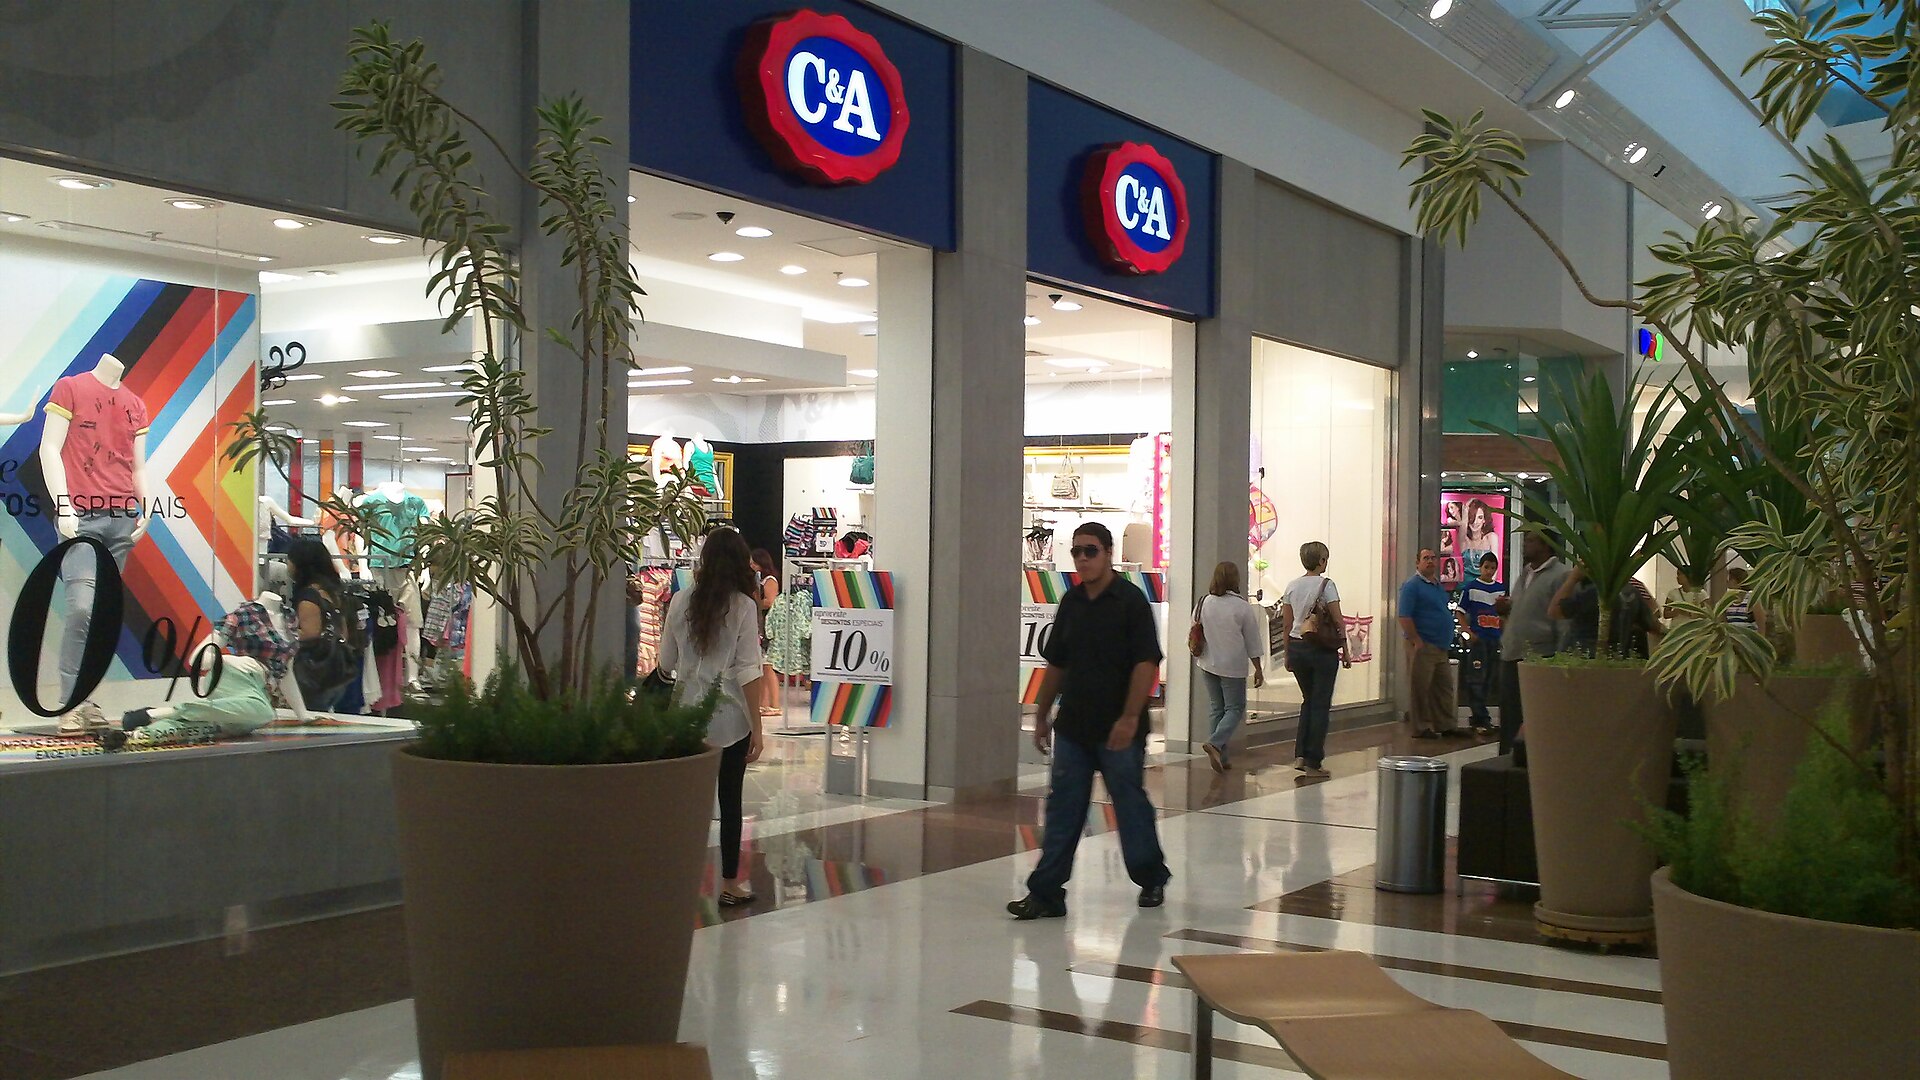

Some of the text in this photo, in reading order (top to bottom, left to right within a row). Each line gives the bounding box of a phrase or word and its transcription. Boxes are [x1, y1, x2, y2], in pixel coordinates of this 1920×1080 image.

[787, 51, 881, 141] C&A
[1115, 174, 1171, 240] C&A
[56, 494, 188, 519] ESPECIAIS
